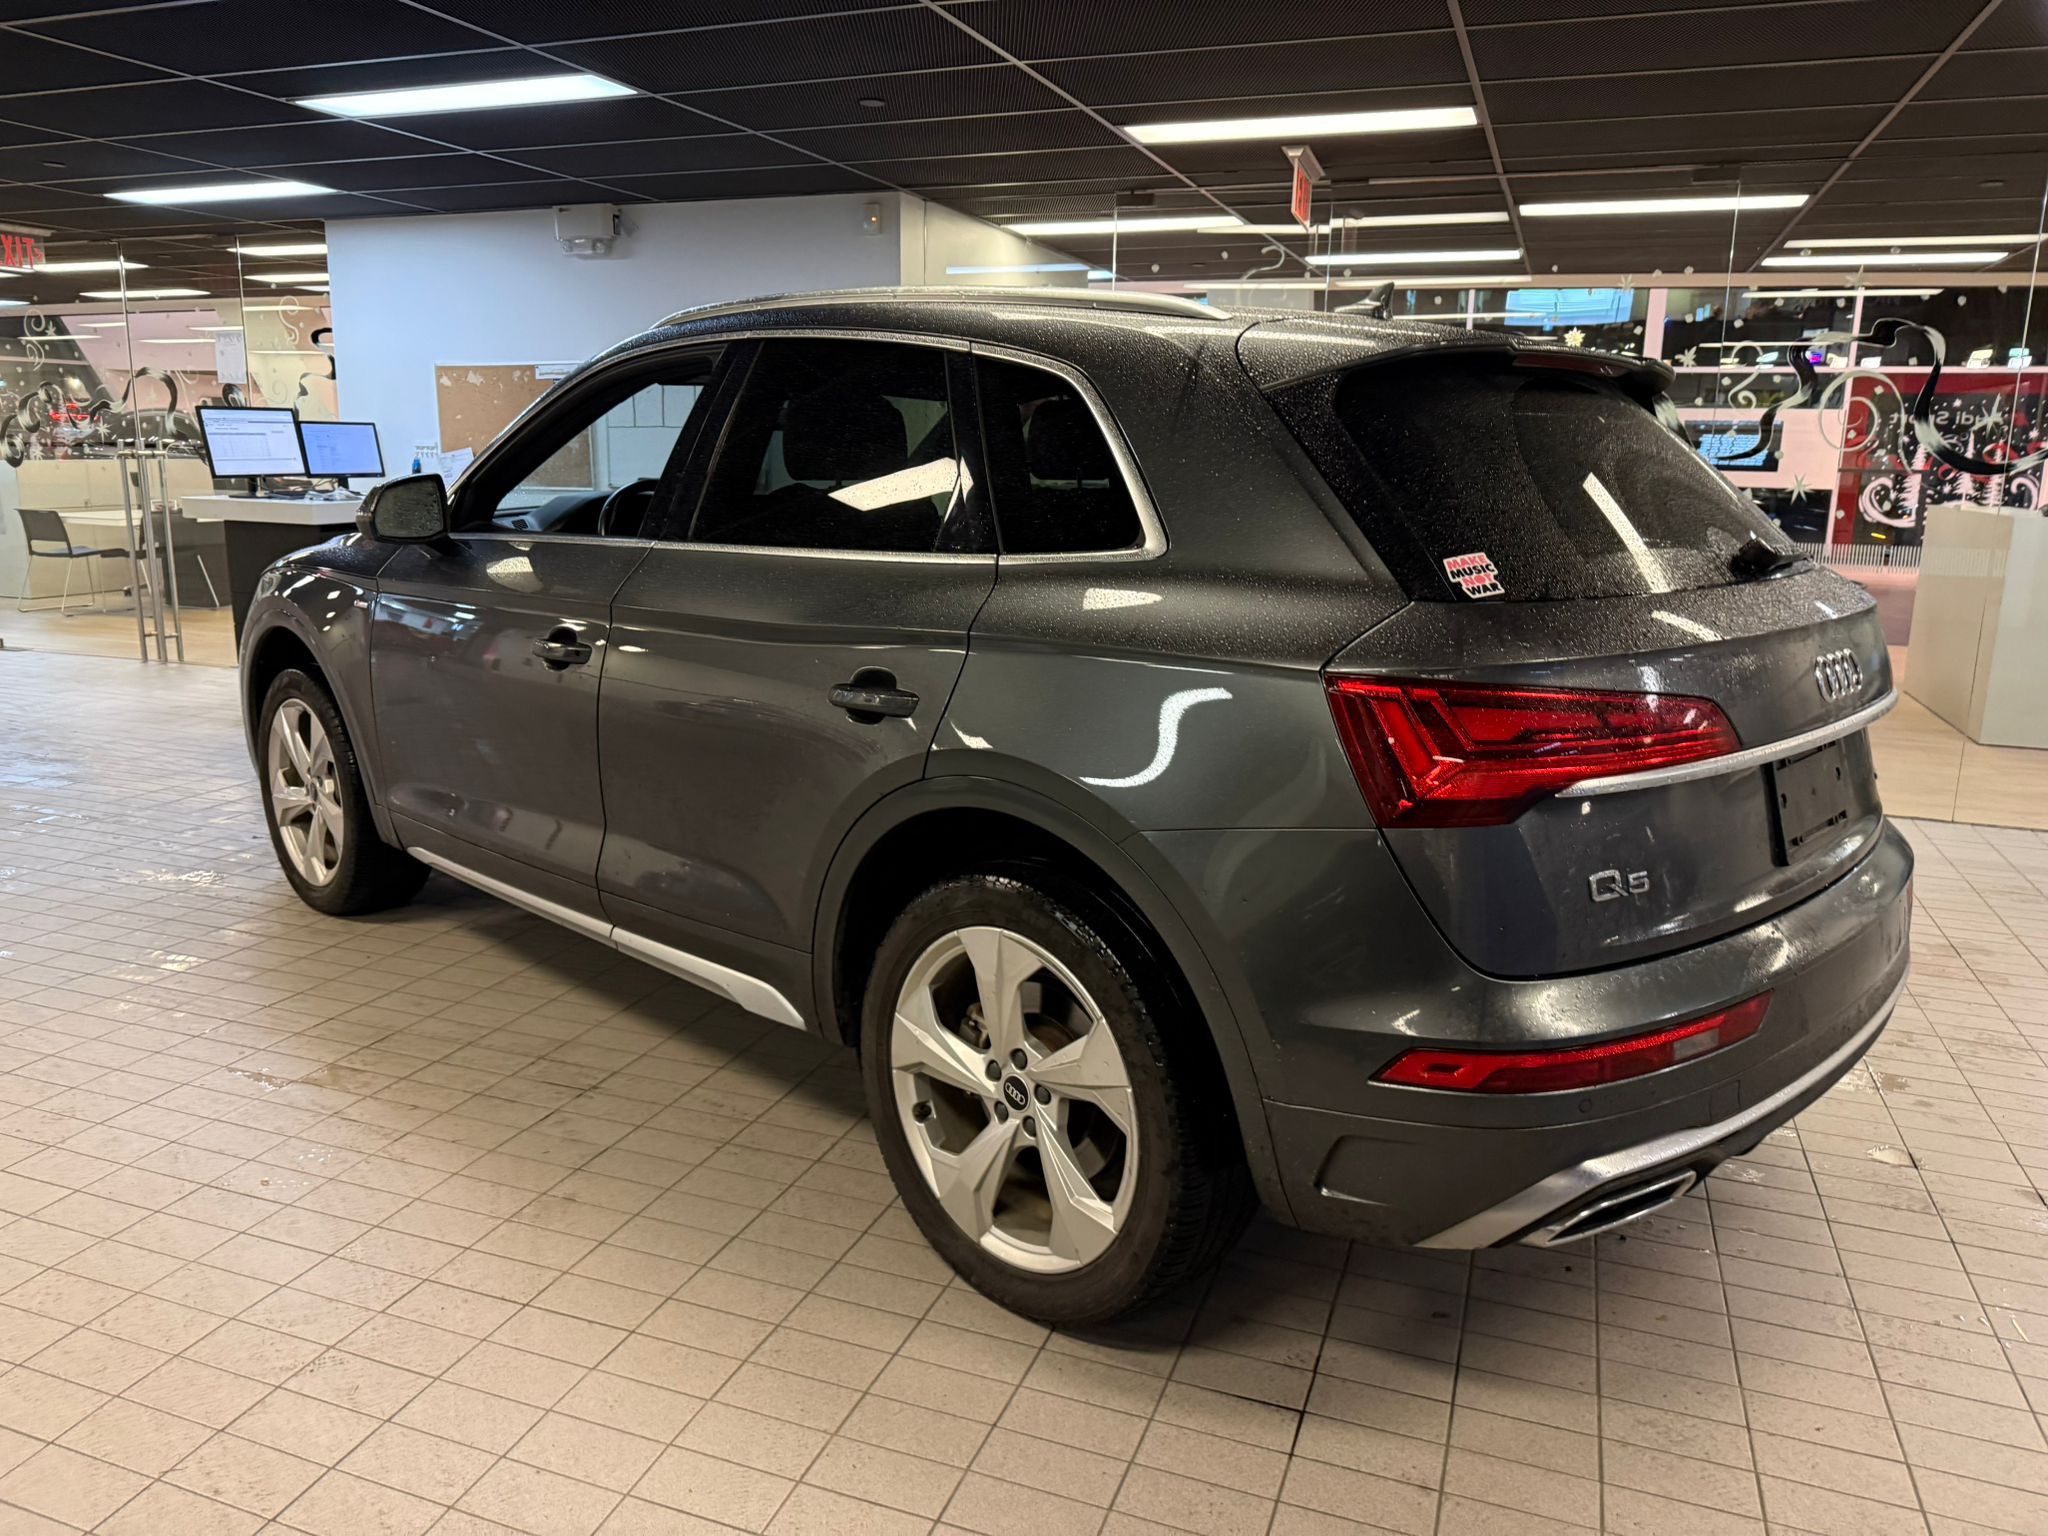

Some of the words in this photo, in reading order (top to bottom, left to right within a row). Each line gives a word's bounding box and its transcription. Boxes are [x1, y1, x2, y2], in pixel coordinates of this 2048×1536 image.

[0, 231, 35, 269] XIT
[1446, 554, 1488, 570] MAKE
[1450, 563, 1495, 580] MUSIC
[1462, 573, 1493, 587] NOT
[1466, 582, 1501, 595] WAR
[1588, 869, 1650, 902] Q5
